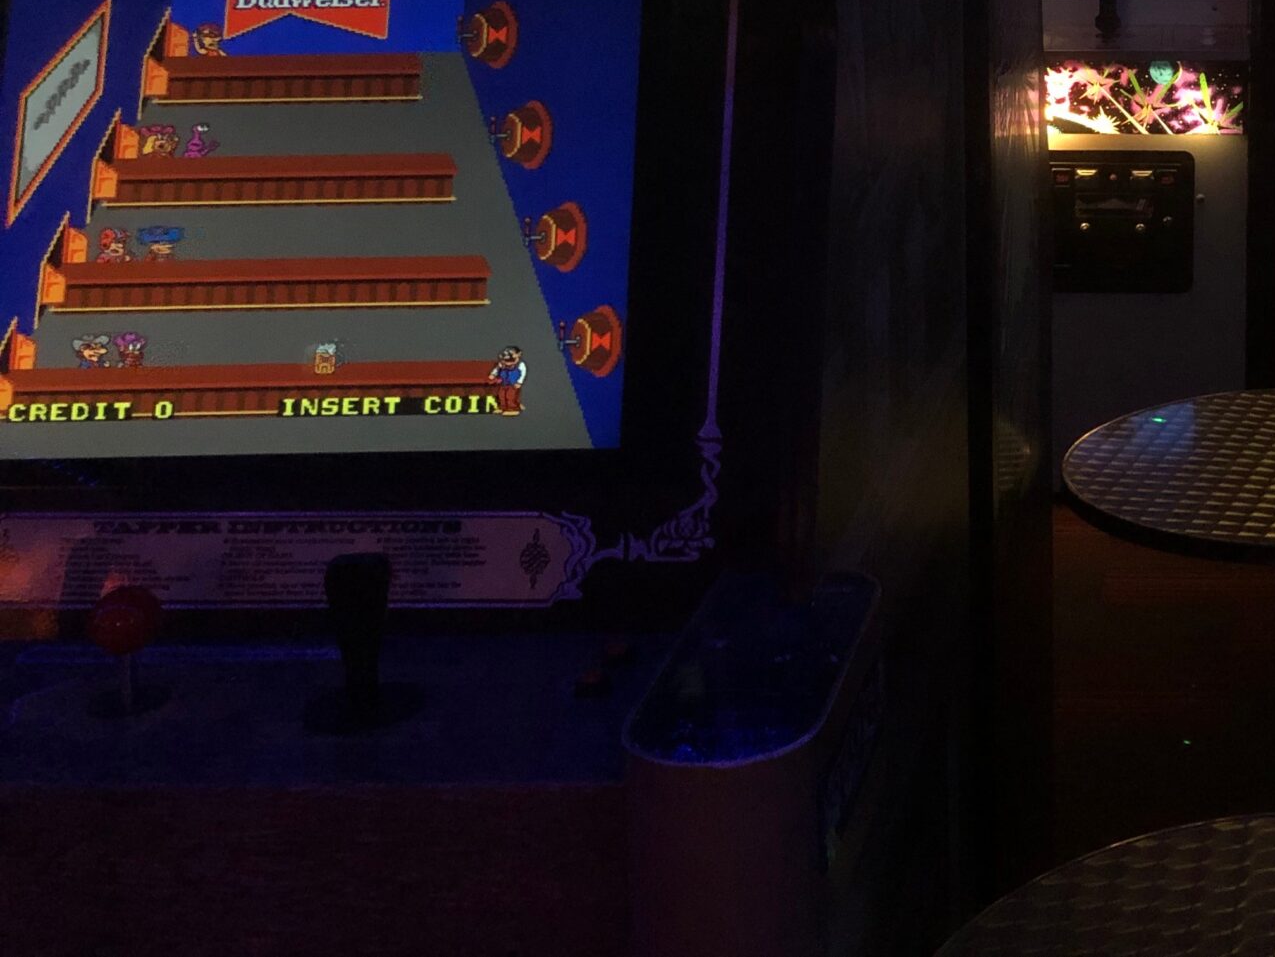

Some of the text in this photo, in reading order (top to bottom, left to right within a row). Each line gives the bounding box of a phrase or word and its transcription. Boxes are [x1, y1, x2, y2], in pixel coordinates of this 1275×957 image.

[8, 400, 174, 422] CREDIT 0
[282, 395, 501, 416] INSERT COIN
